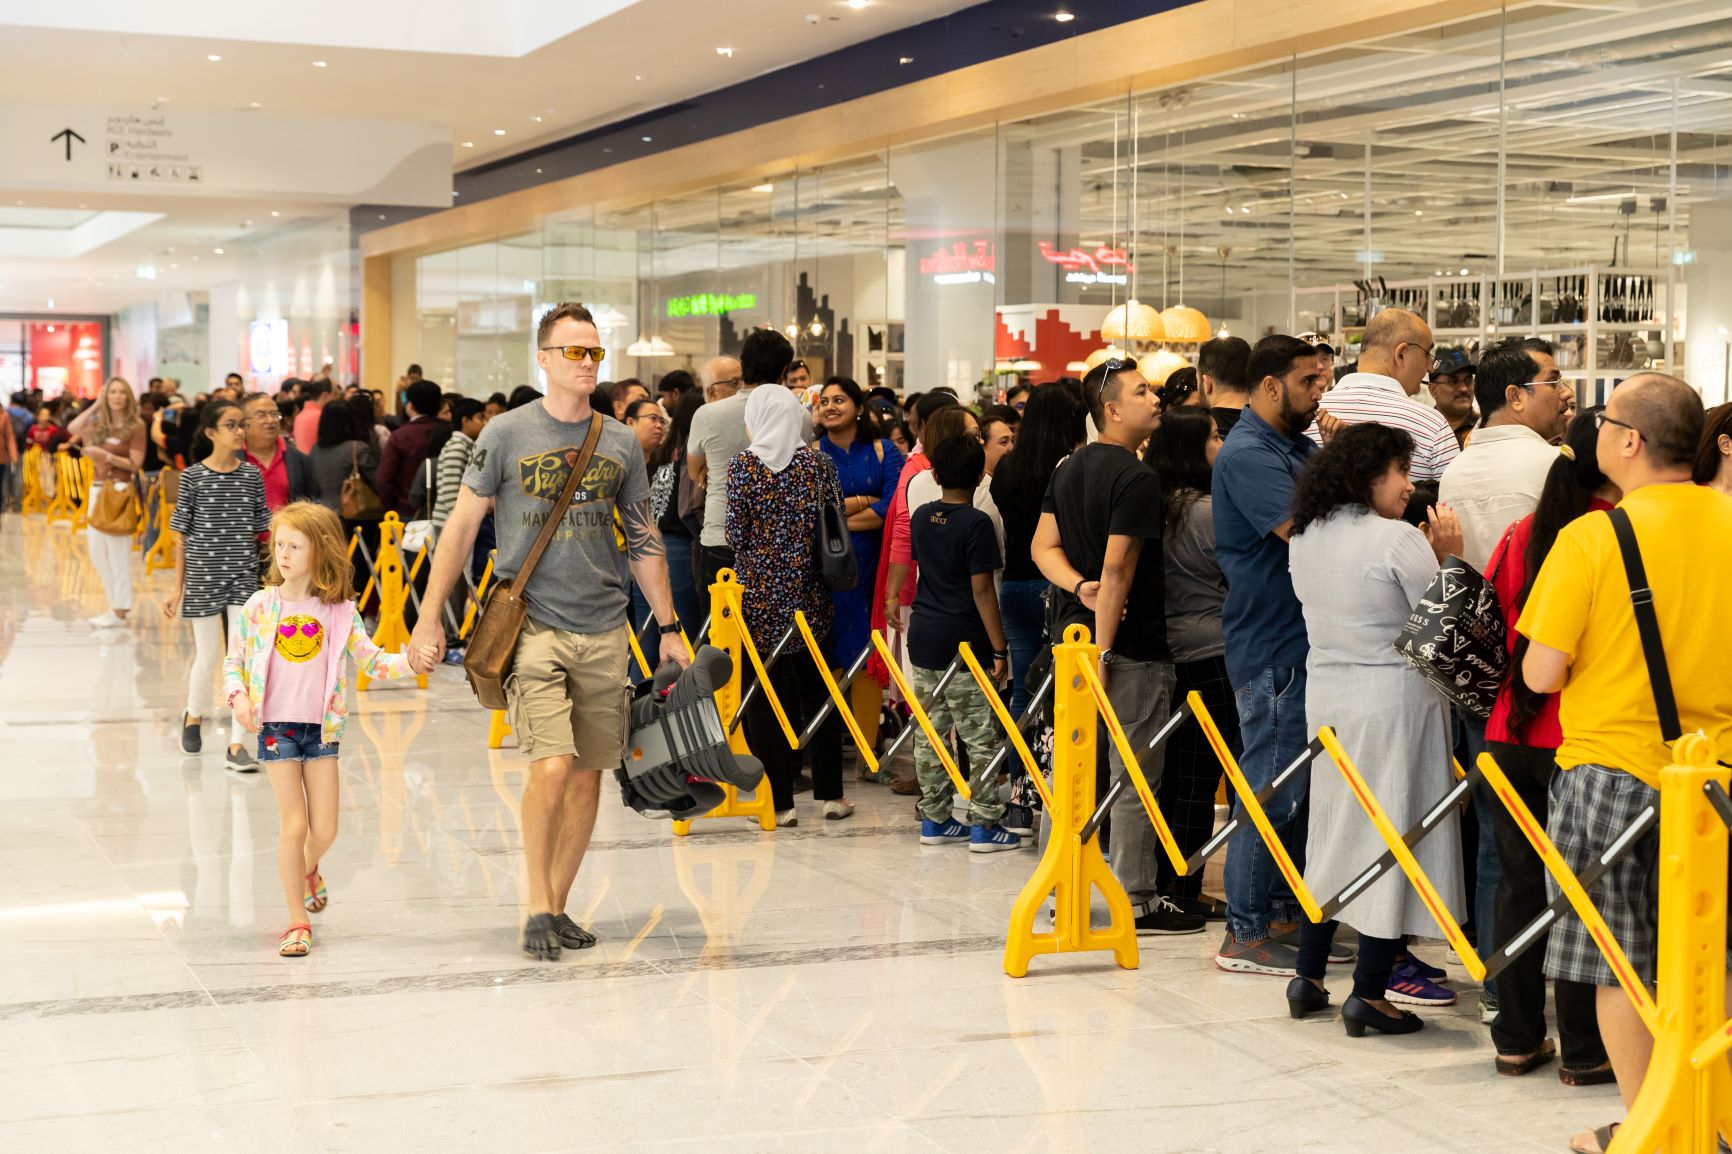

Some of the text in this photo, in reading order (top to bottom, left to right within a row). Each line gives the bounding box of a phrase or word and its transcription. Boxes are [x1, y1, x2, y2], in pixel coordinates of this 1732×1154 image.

[128, 126, 174, 137] Hardware
[521, 453, 622, 498] Supedry
[1456, 692, 1491, 718] UESS
